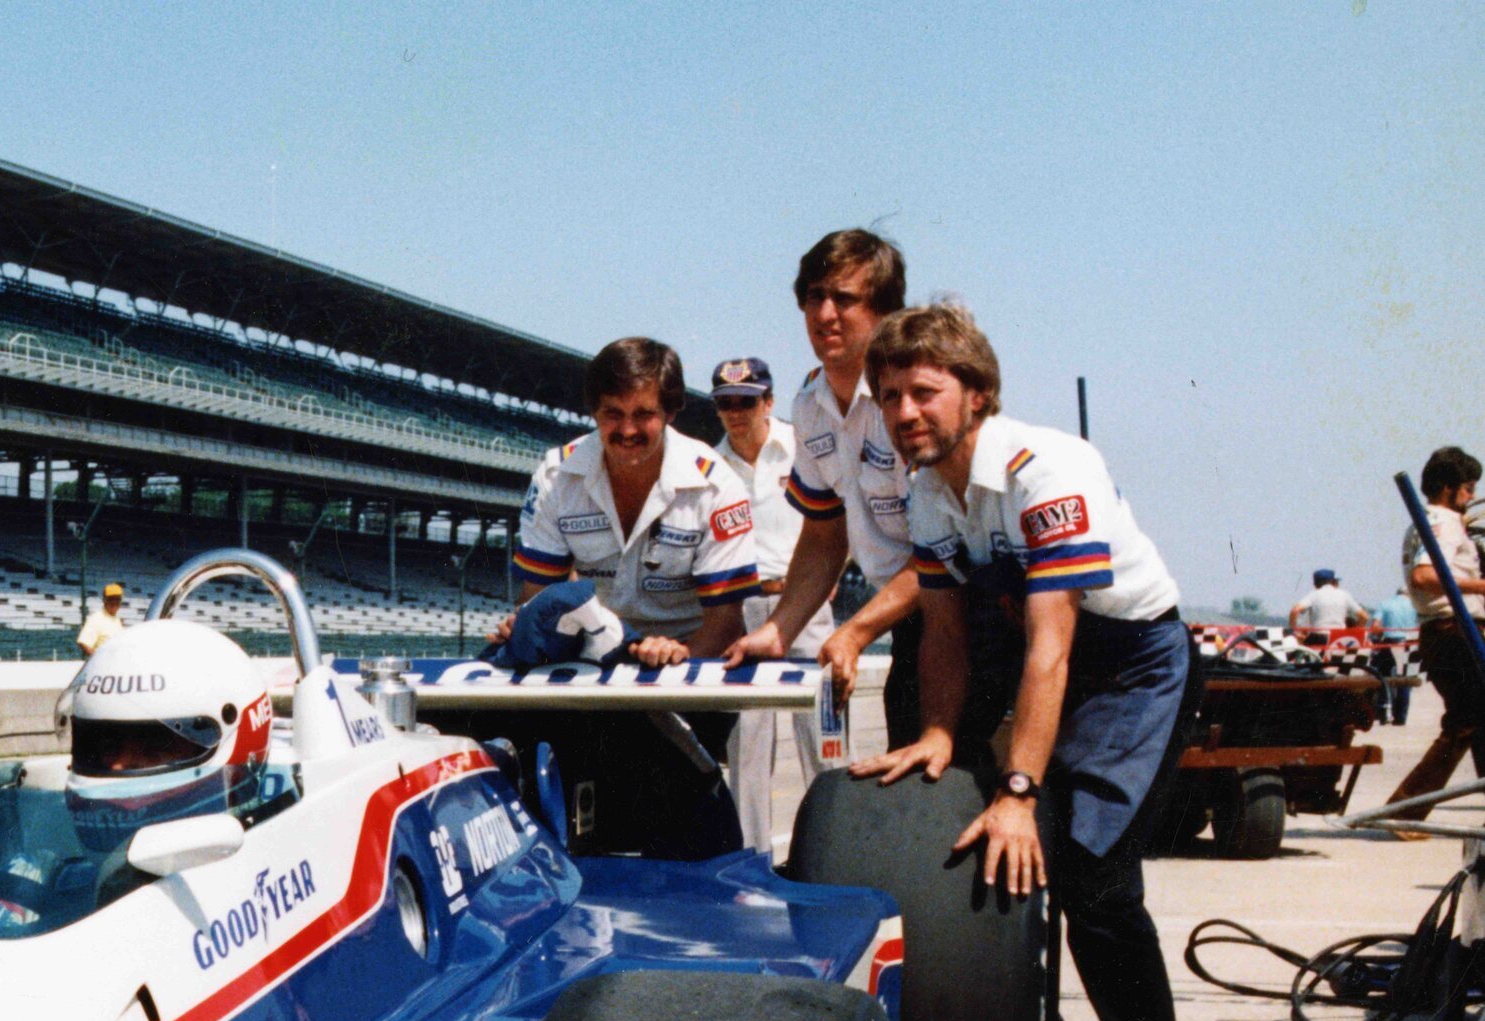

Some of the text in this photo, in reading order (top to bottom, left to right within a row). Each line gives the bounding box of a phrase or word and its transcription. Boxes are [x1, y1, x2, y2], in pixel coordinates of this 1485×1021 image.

[872, 502, 902, 512] NORT
[1025, 499, 1082, 536] CAM2
[86, 673, 167, 695] GOULD
[325, 678, 357, 748] 1
[351, 713, 385, 747] MEARS
[193, 859, 316, 970] GOODYEAR
